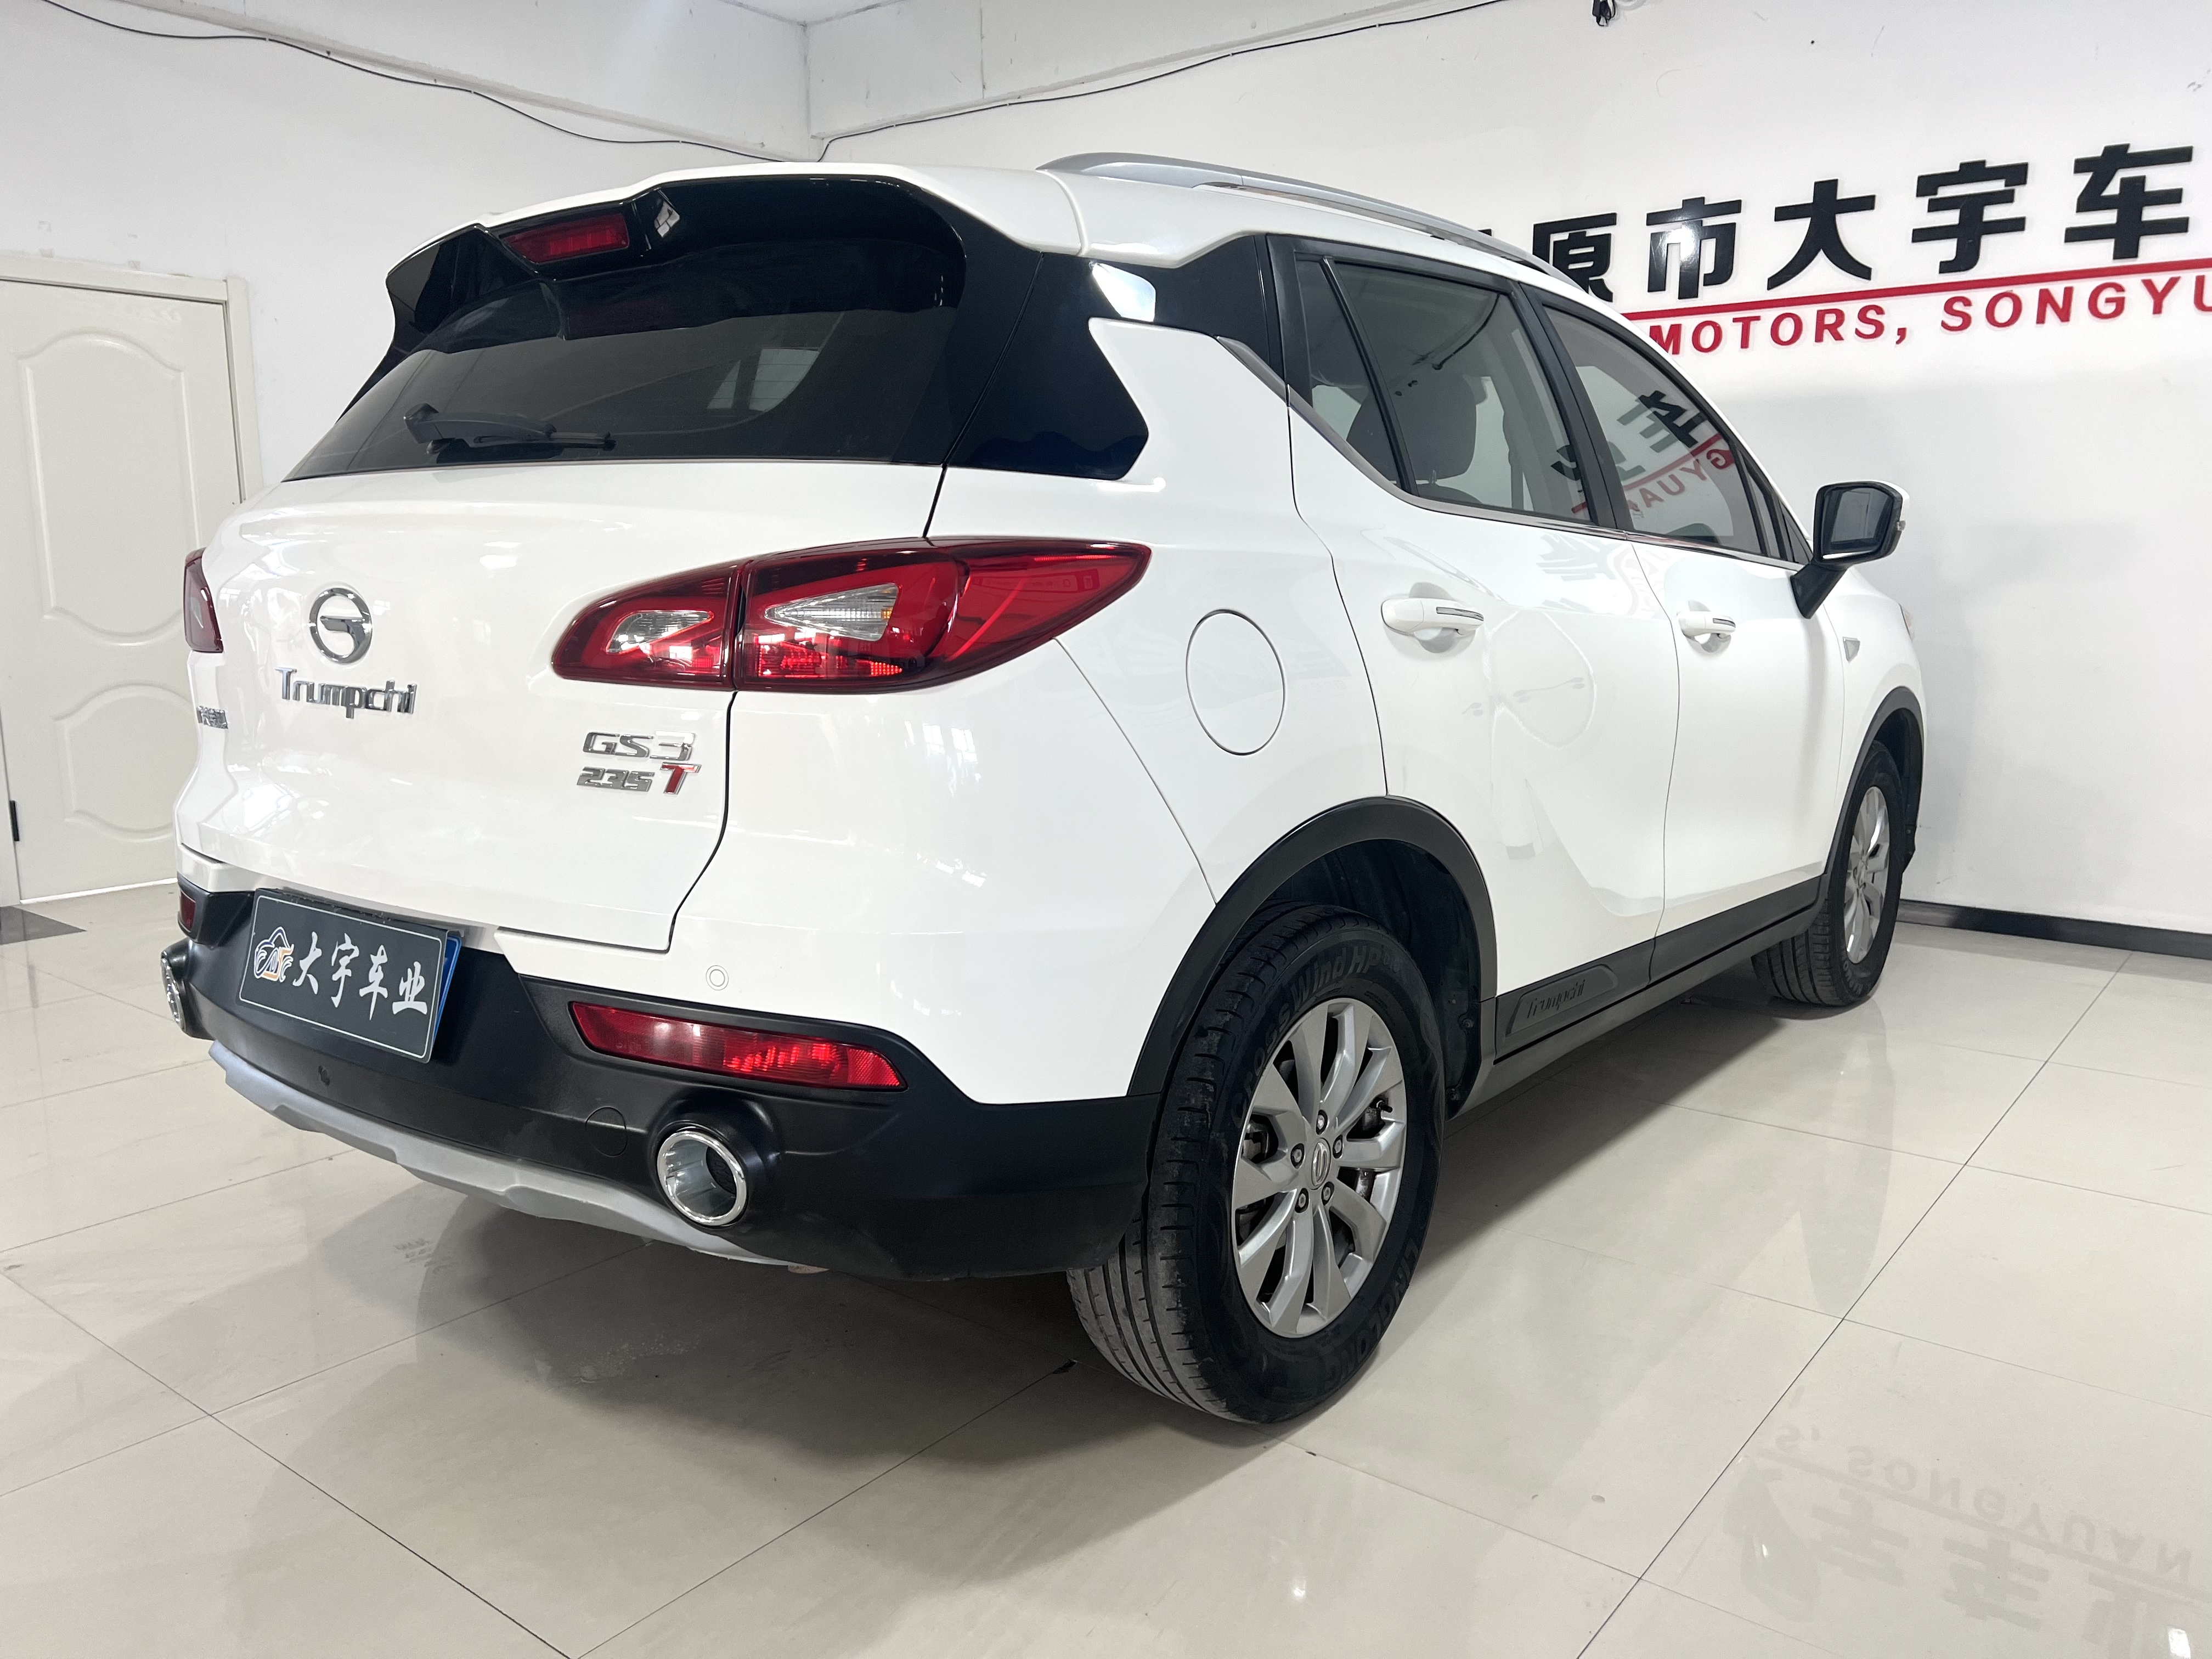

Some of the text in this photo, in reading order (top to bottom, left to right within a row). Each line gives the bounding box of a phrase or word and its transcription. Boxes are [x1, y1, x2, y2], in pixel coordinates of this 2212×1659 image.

[1478, 143, 2193, 302] 原市大宇车
[1649, 304, 1907, 355] MOTORS,
[275, 667, 417, 719] Trumpchi
[583, 730, 696, 761] GS3
[293, 932, 427, 1020] 大宇车业
[1526, 979, 1586, 1018] Trumpchi
